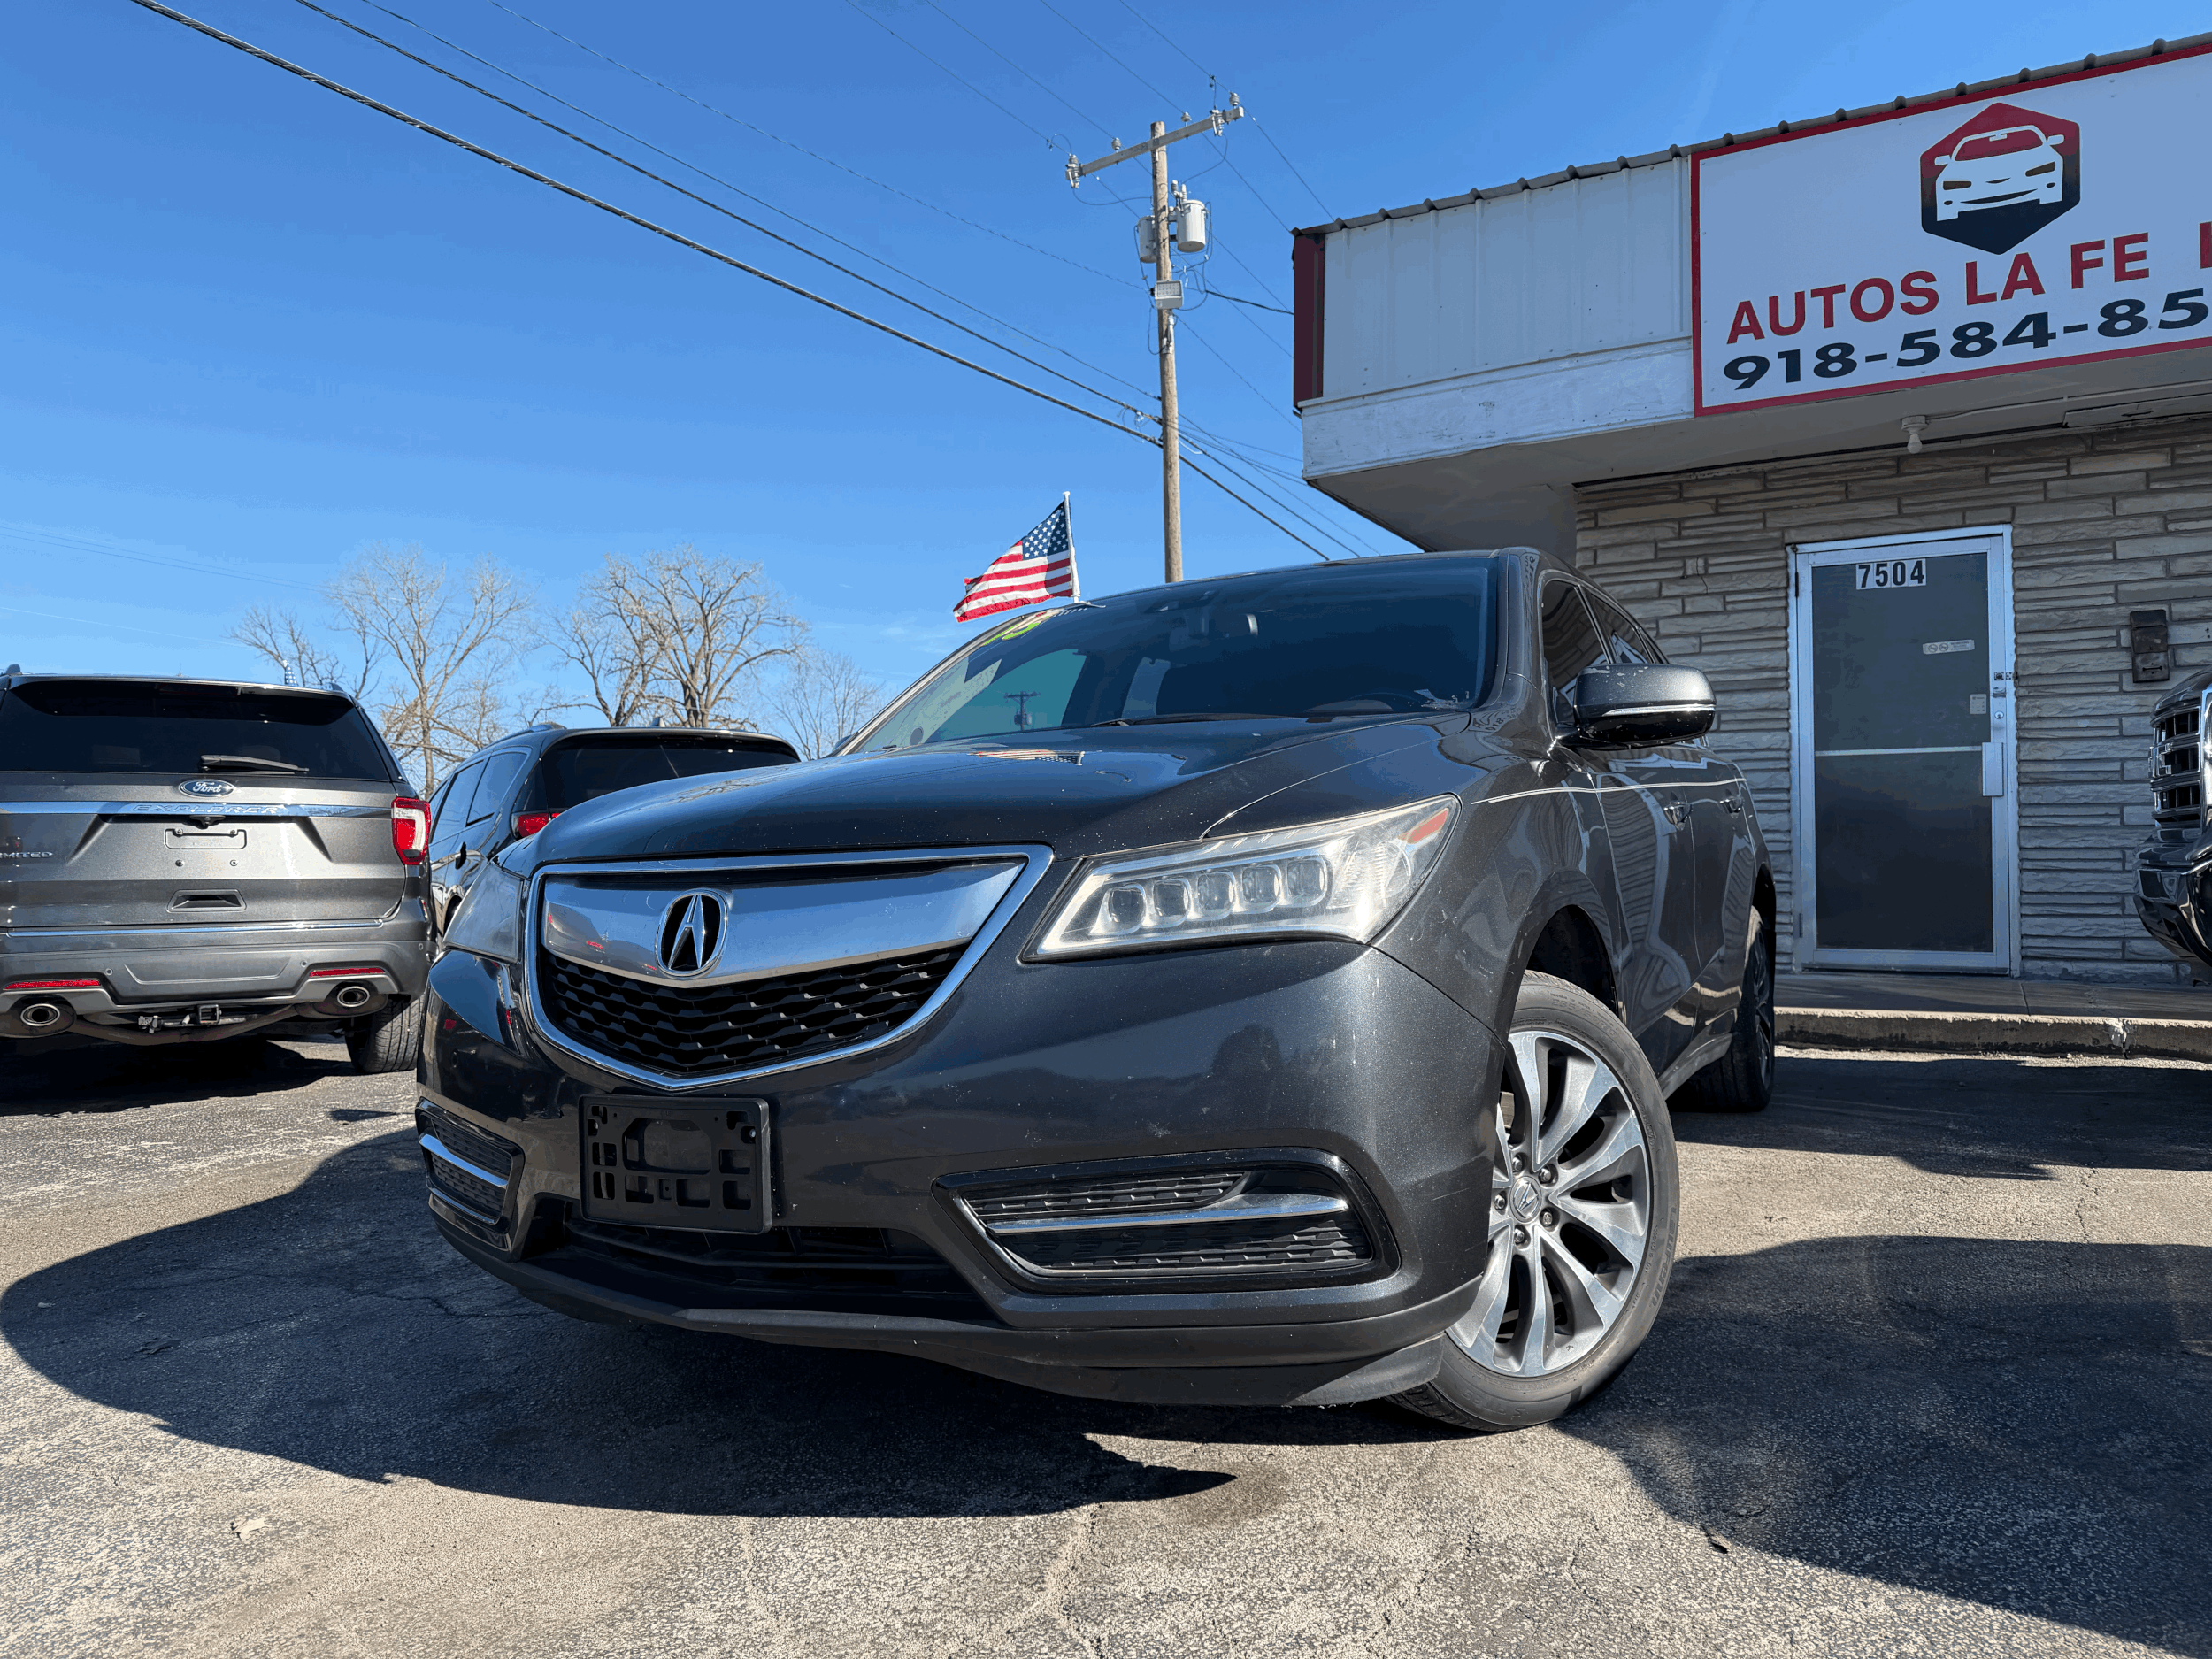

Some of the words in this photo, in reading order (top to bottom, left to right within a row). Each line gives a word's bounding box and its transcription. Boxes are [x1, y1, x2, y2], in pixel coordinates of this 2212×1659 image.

[1726, 270, 1939, 345] AUTOS
[1965, 252, 2046, 306] LA
[2070, 232, 2149, 290] FE
[1723, 288, 2209, 392] 918-584-85
[1858, 560, 1924, 588] 7504
[191, 781, 222, 794] Ford
[133, 804, 281, 816] EXPLORER
